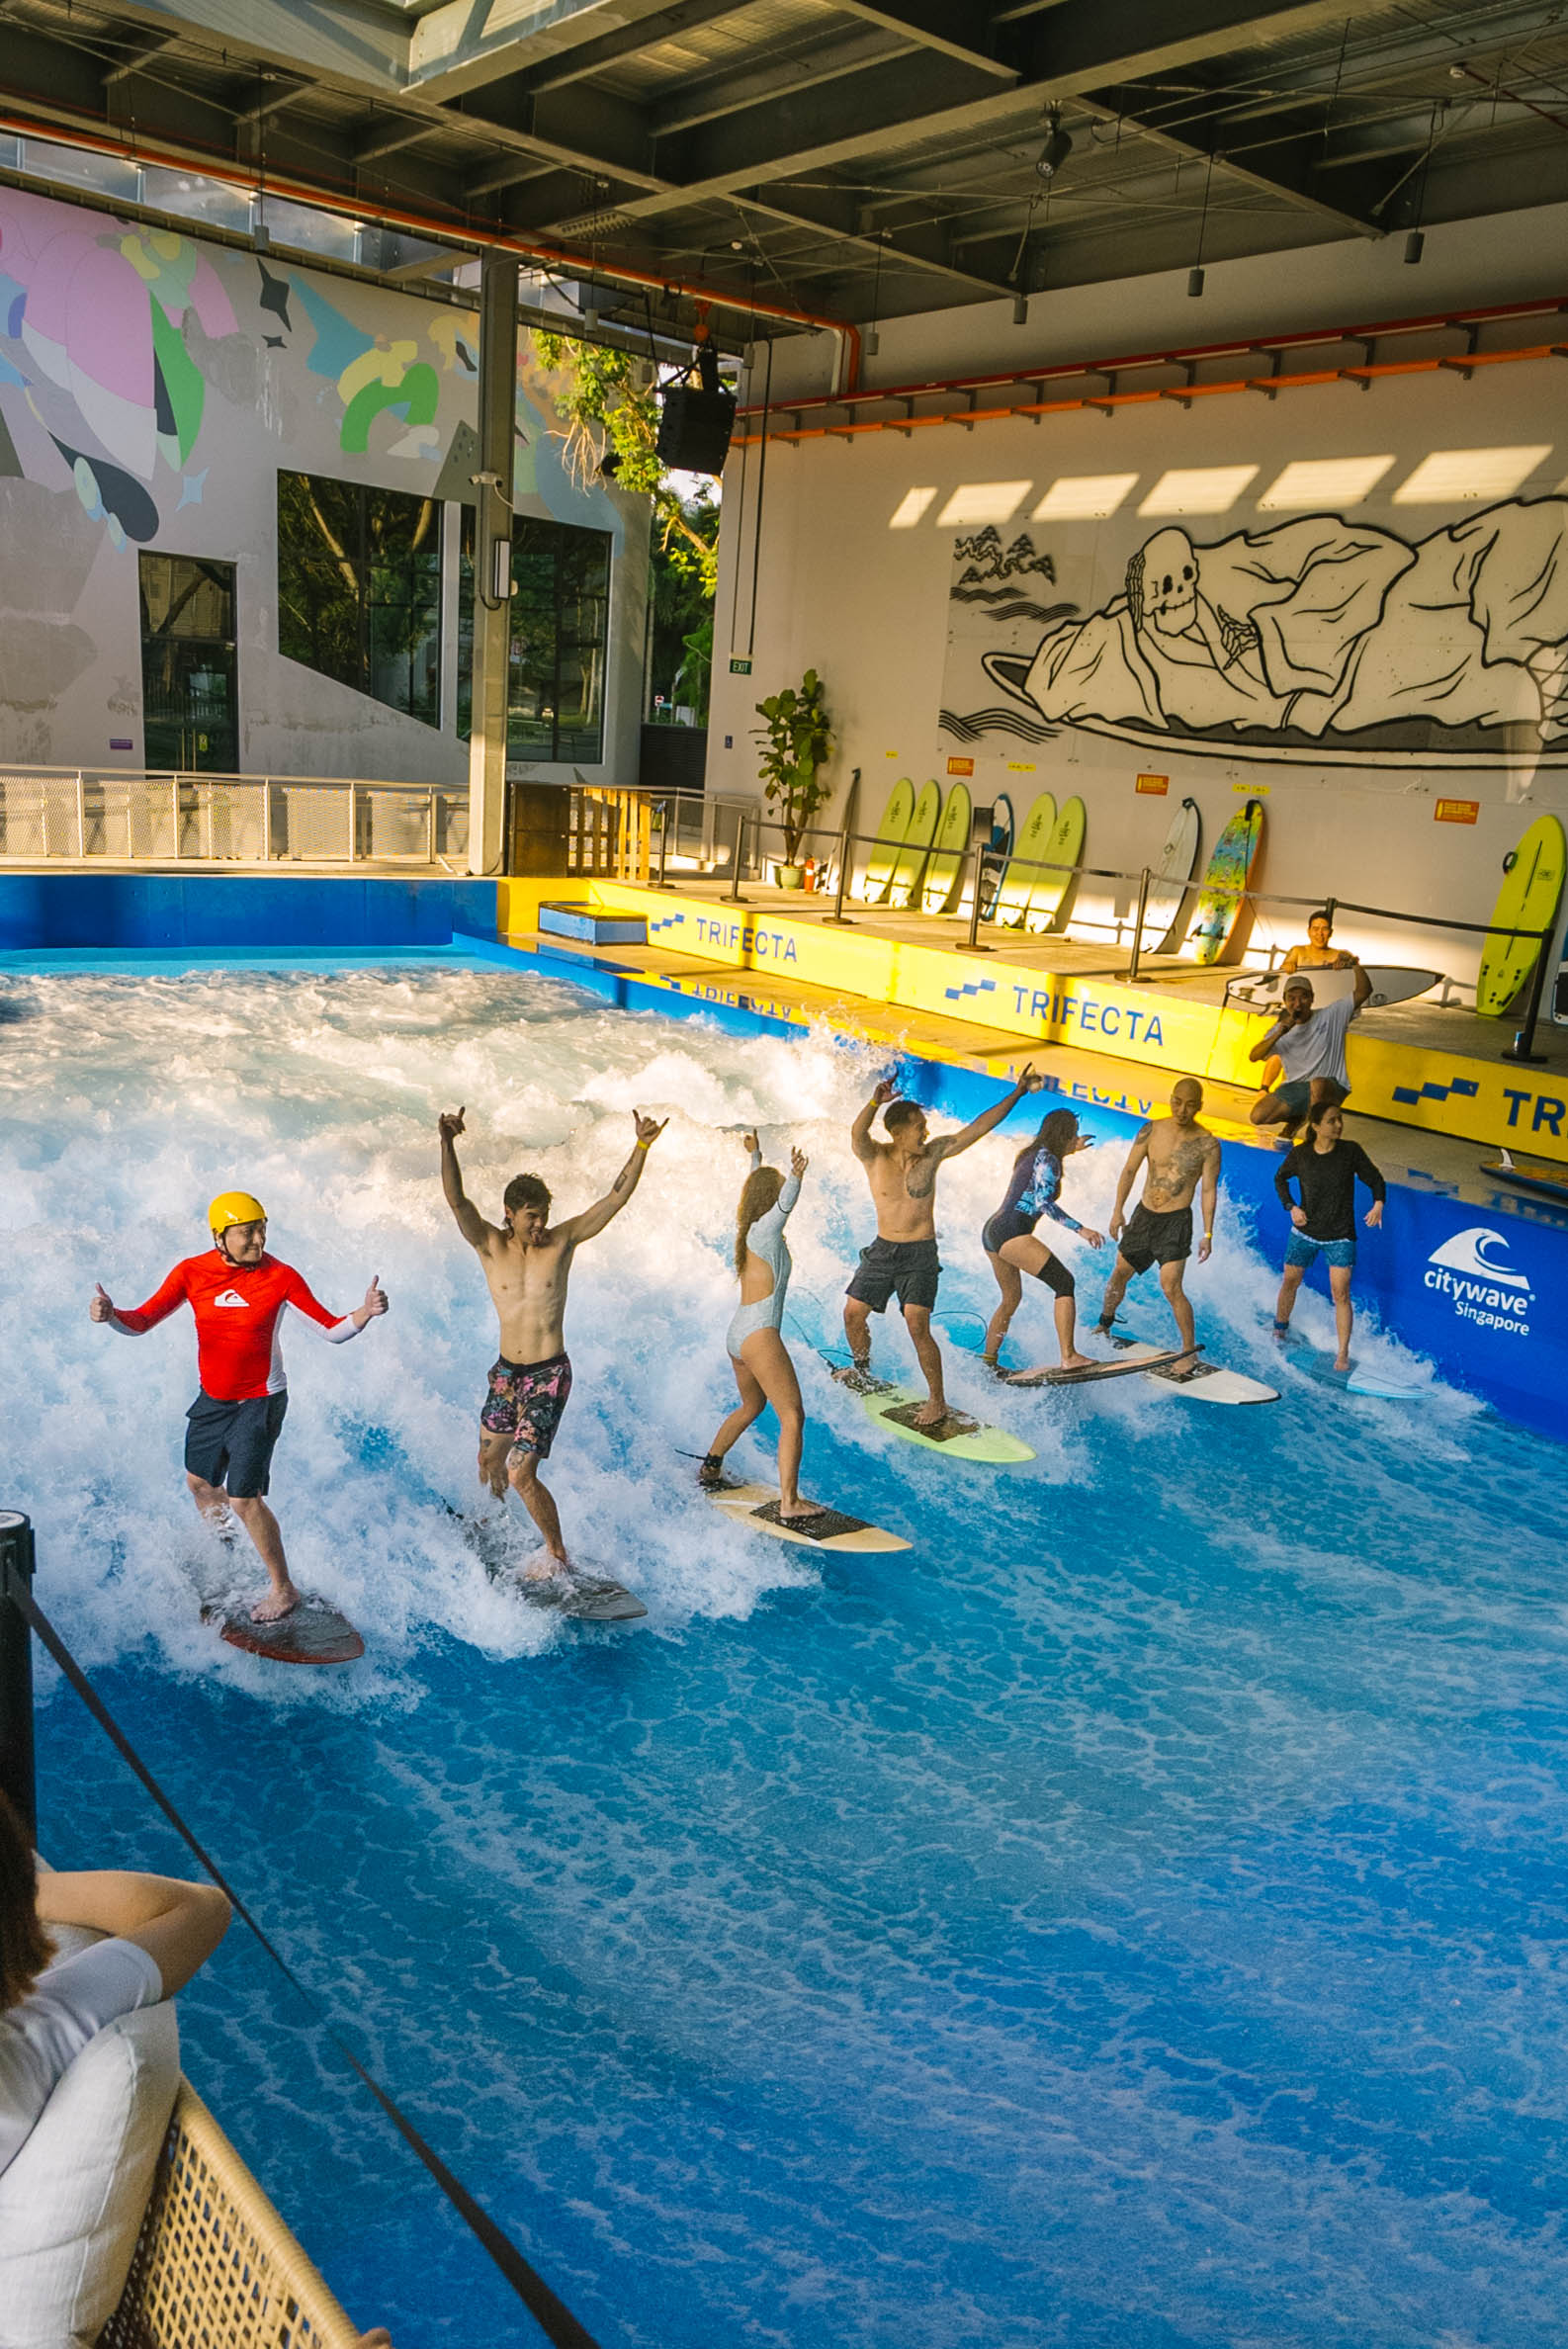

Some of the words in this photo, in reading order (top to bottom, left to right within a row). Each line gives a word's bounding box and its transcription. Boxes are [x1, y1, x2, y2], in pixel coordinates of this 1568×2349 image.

[732, 661, 749, 673] EXIT
[696, 917, 797, 963] TRIFECTA
[1013, 986, 1164, 1046] TRIFECTA
[1455, 1301, 1530, 1336] Singapore
